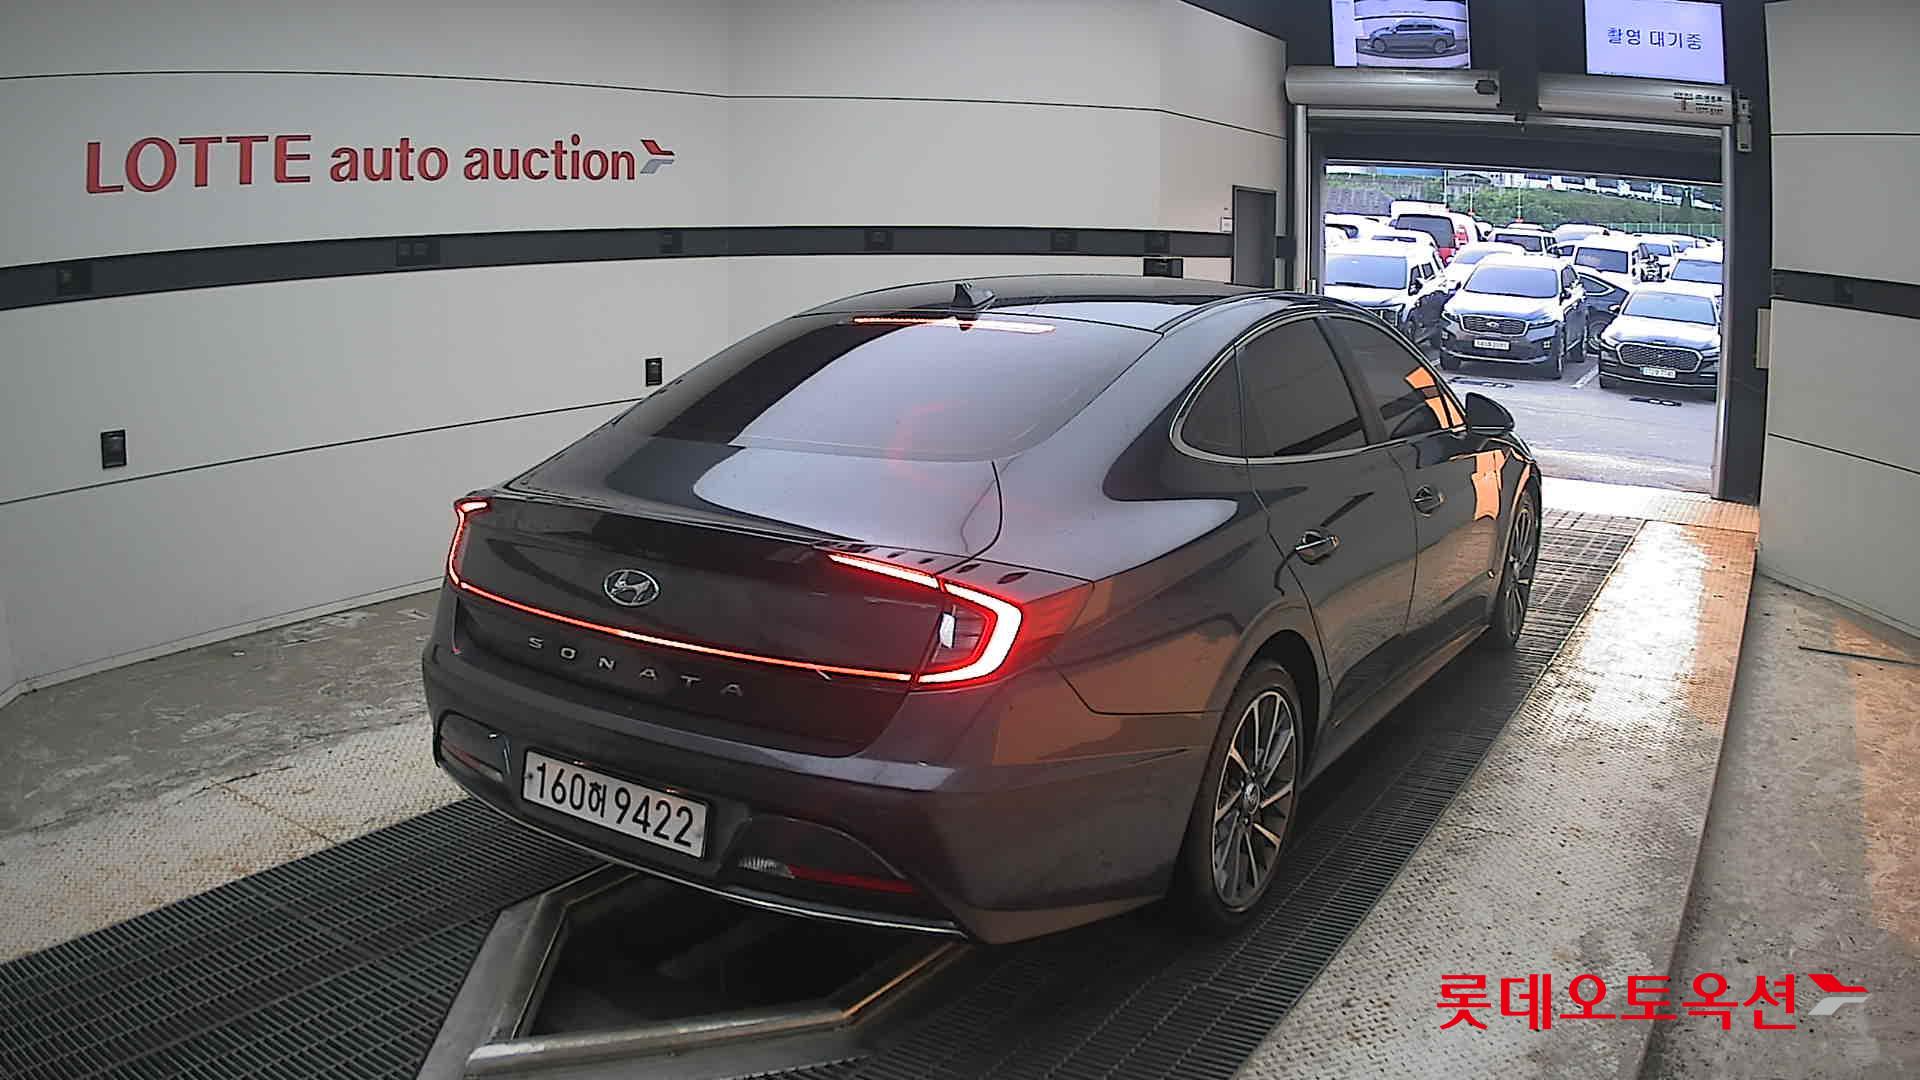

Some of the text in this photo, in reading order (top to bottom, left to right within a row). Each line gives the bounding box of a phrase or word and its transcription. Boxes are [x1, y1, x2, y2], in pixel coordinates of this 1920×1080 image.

[1607, 27, 1703, 50] 촬영 대기중
[86, 133, 636, 194] LOTTE auto auction
[527, 636, 744, 697] SONATA
